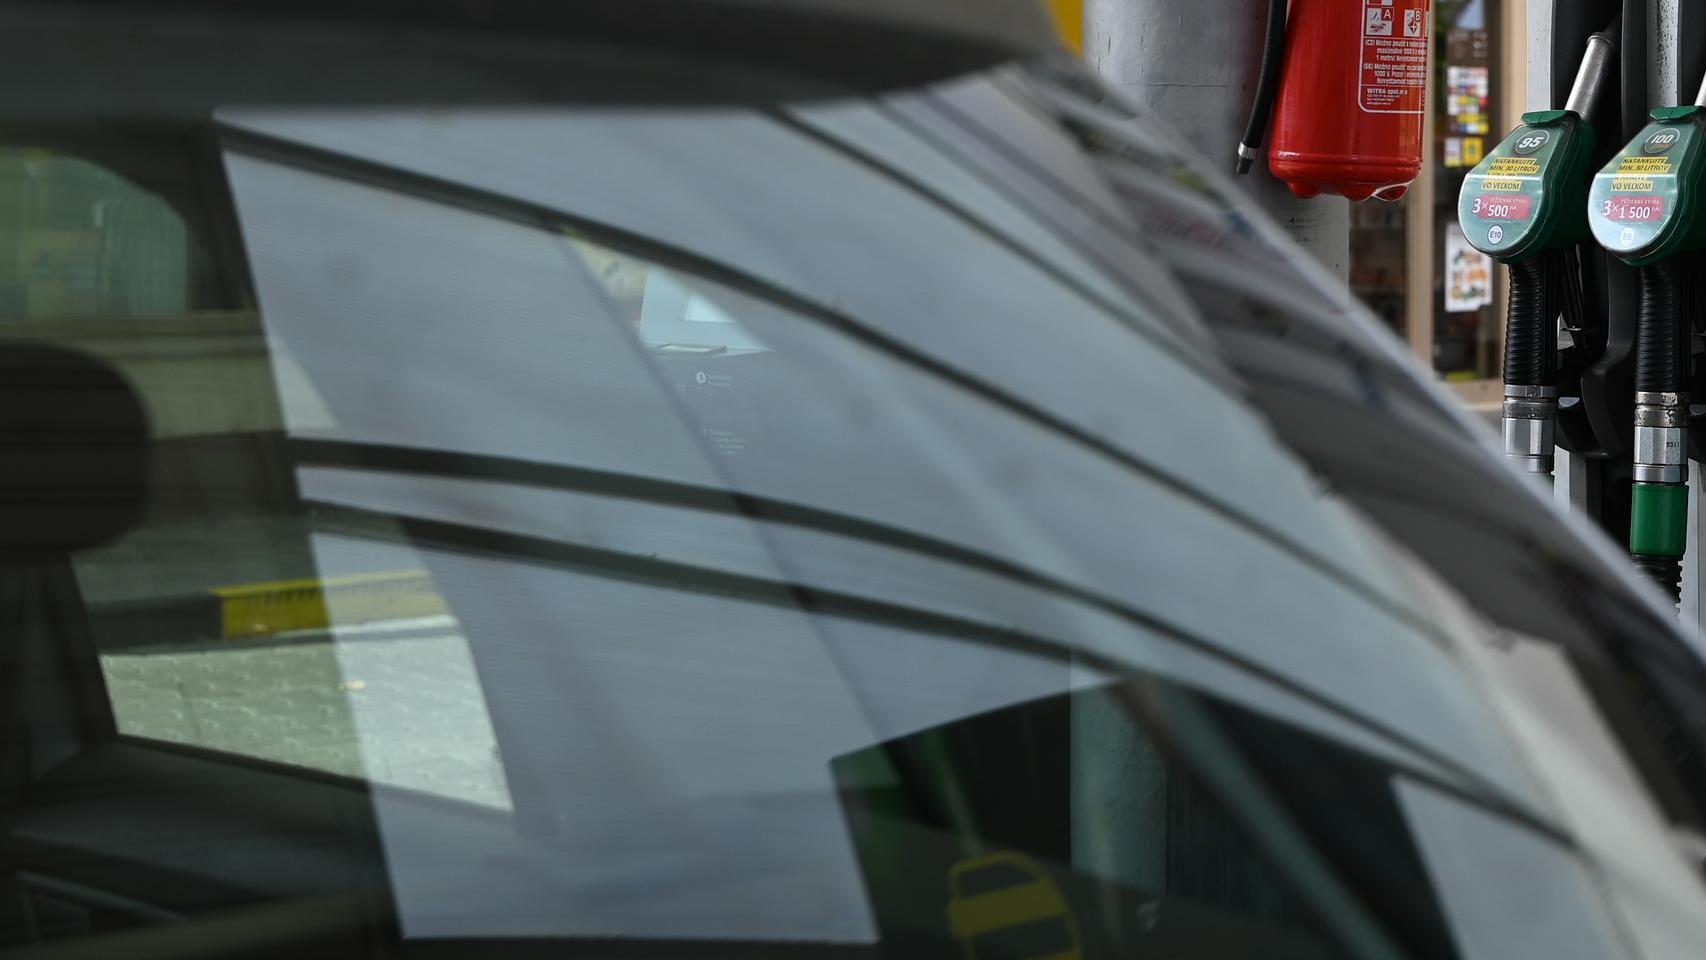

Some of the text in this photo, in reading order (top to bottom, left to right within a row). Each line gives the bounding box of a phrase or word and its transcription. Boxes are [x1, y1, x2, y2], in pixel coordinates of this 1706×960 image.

[1383, 9, 1421, 21] A B
[1519, 137, 1544, 148] 95
[1650, 135, 1674, 144] 100
[1490, 230, 1501, 238] E10
